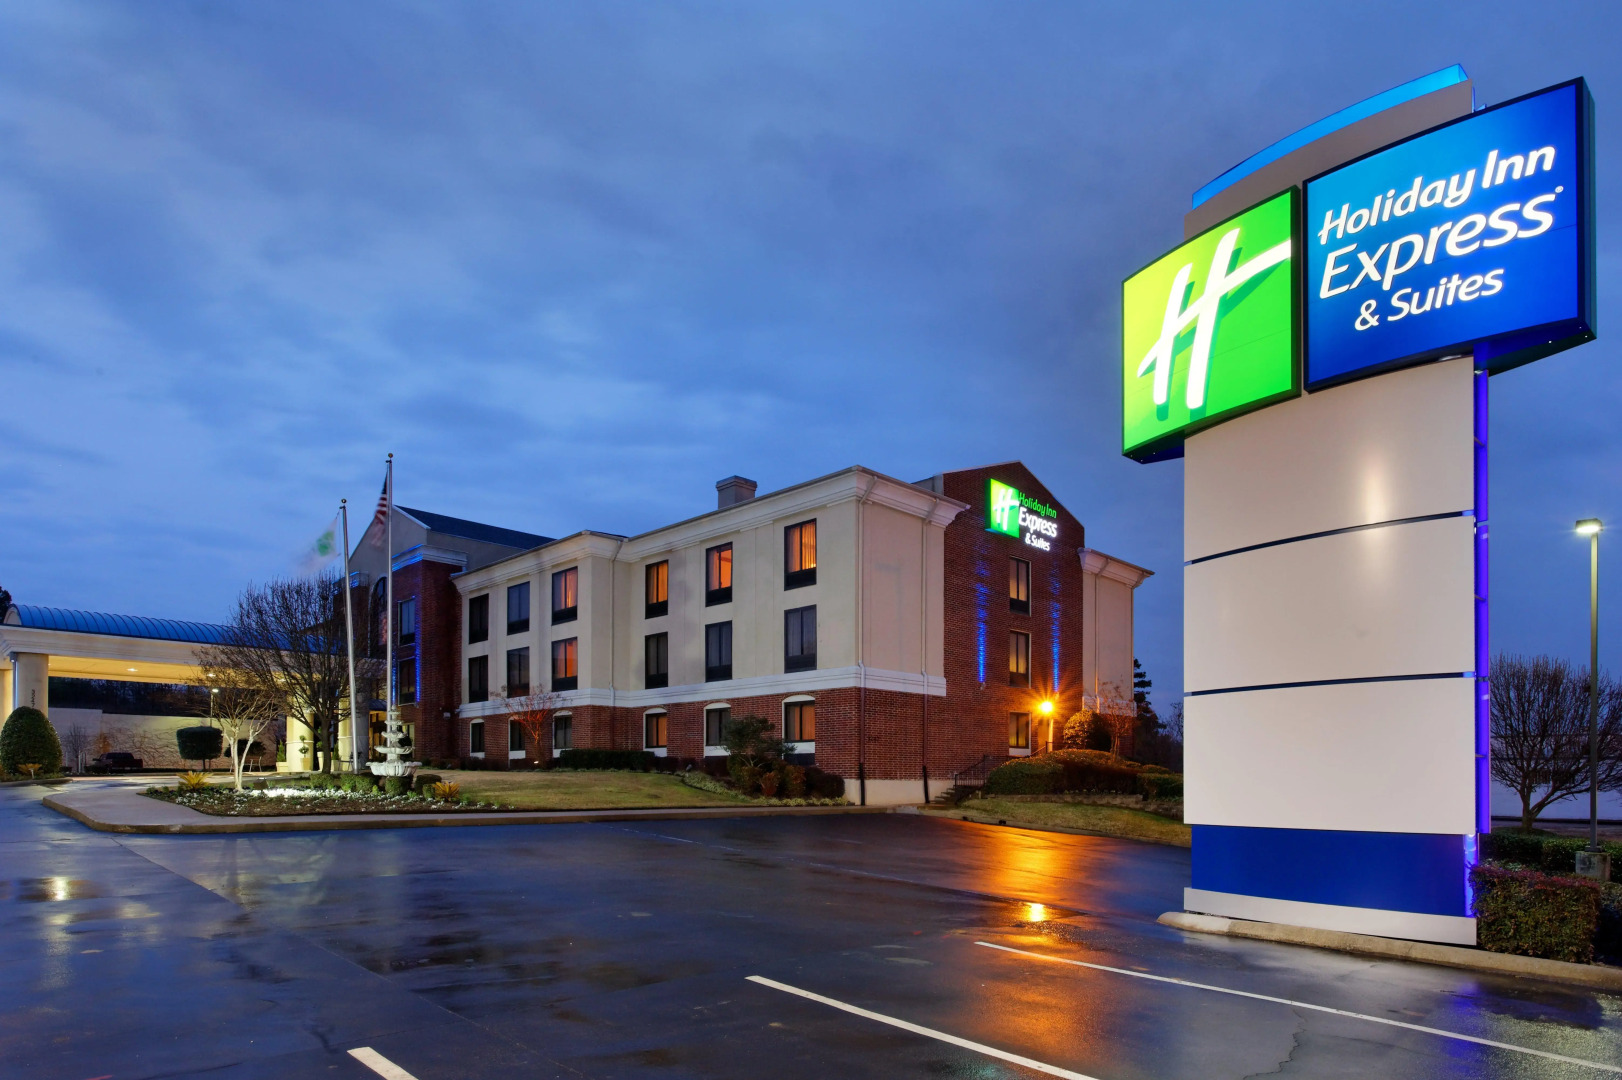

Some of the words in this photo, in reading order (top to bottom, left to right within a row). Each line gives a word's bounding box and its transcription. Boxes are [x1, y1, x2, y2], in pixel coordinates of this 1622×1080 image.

[1318, 169, 1476, 245] Holiday
[1481, 146, 1556, 189] Inn
[1354, 299, 1380, 331] &
[1387, 269, 1504, 322] Suites
[1019, 492, 1046, 516] Holiday
[1046, 504, 1057, 519] Inn
[1018, 506, 1058, 538] Express
[1025, 533, 1031, 545] &
[1031, 534, 1050, 551] Suites
